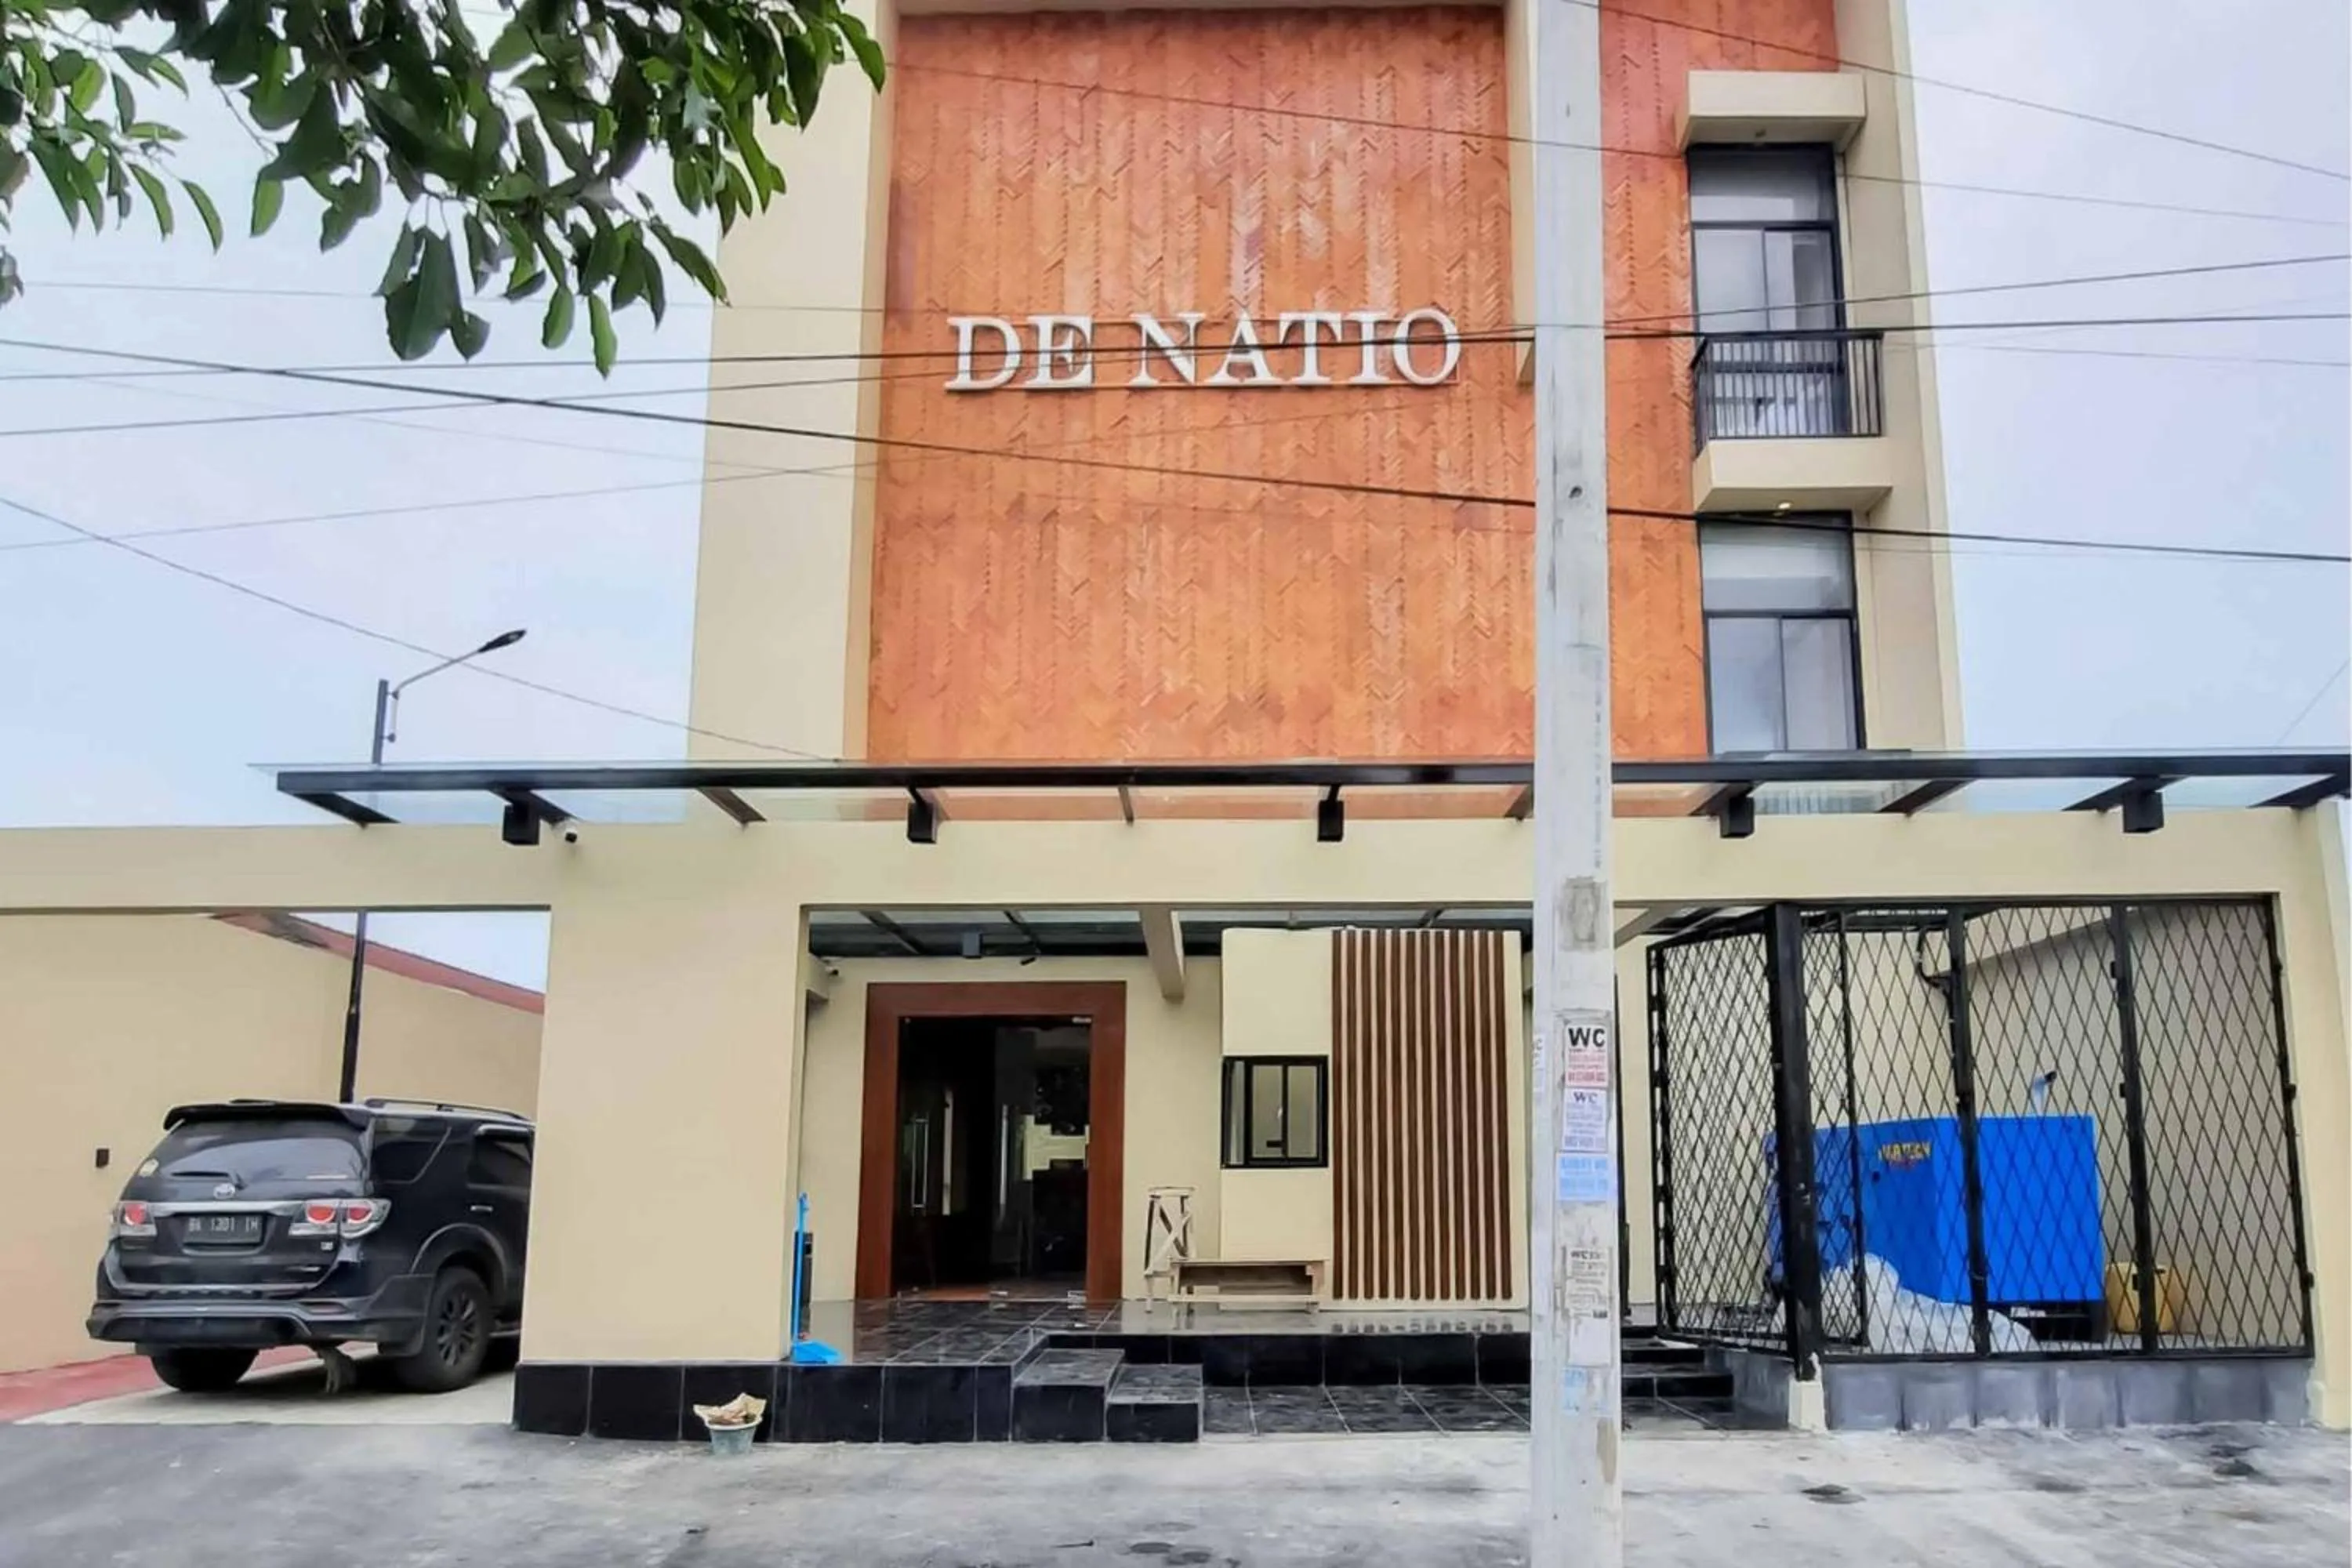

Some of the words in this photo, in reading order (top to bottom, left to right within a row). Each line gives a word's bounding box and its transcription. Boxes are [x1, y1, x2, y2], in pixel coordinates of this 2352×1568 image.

[945, 315, 1094, 390] DE
[1129, 308, 1461, 388] NATIO
[1568, 1026, 1606, 1047] WC
[1573, 1091, 1599, 1104] WC
